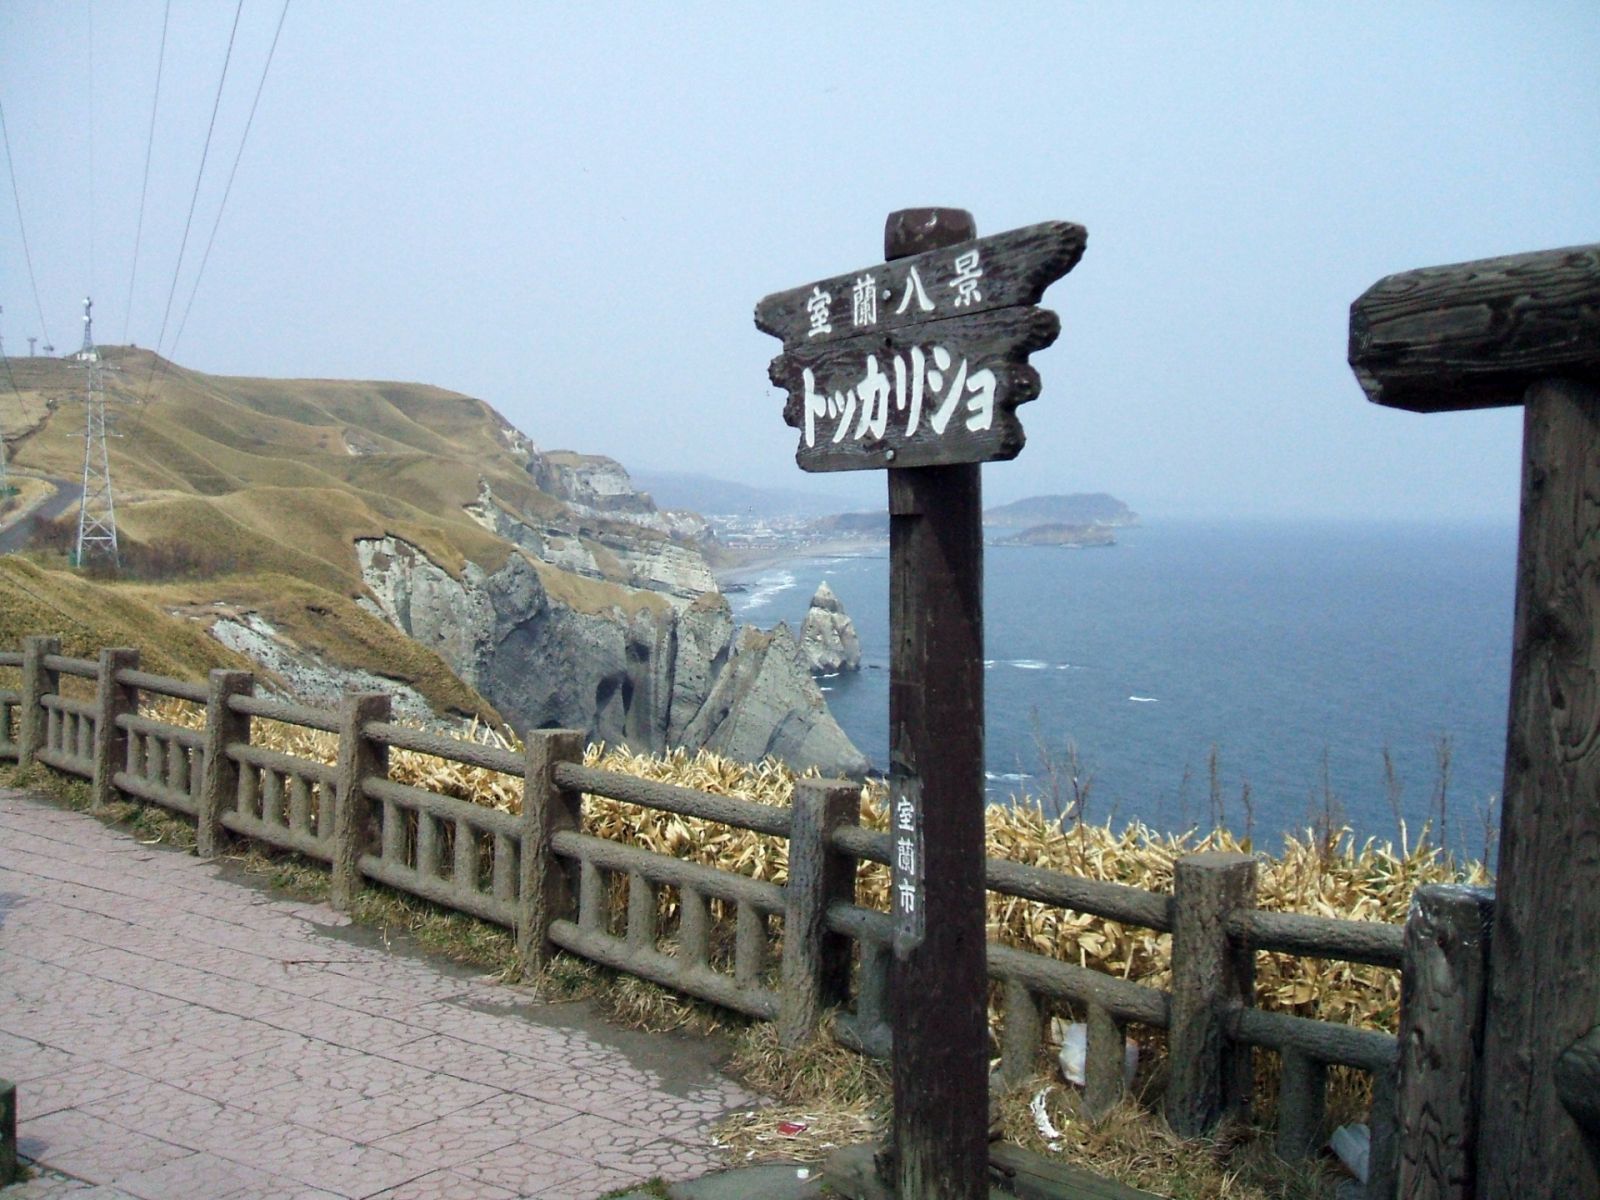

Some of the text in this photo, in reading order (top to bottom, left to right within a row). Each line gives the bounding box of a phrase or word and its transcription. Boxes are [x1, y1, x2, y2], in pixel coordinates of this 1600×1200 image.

[807, 250, 983, 338] 室蘭八景
[803, 346, 996, 448] トッカリショ
[897, 796, 916, 914] 室蘭市
